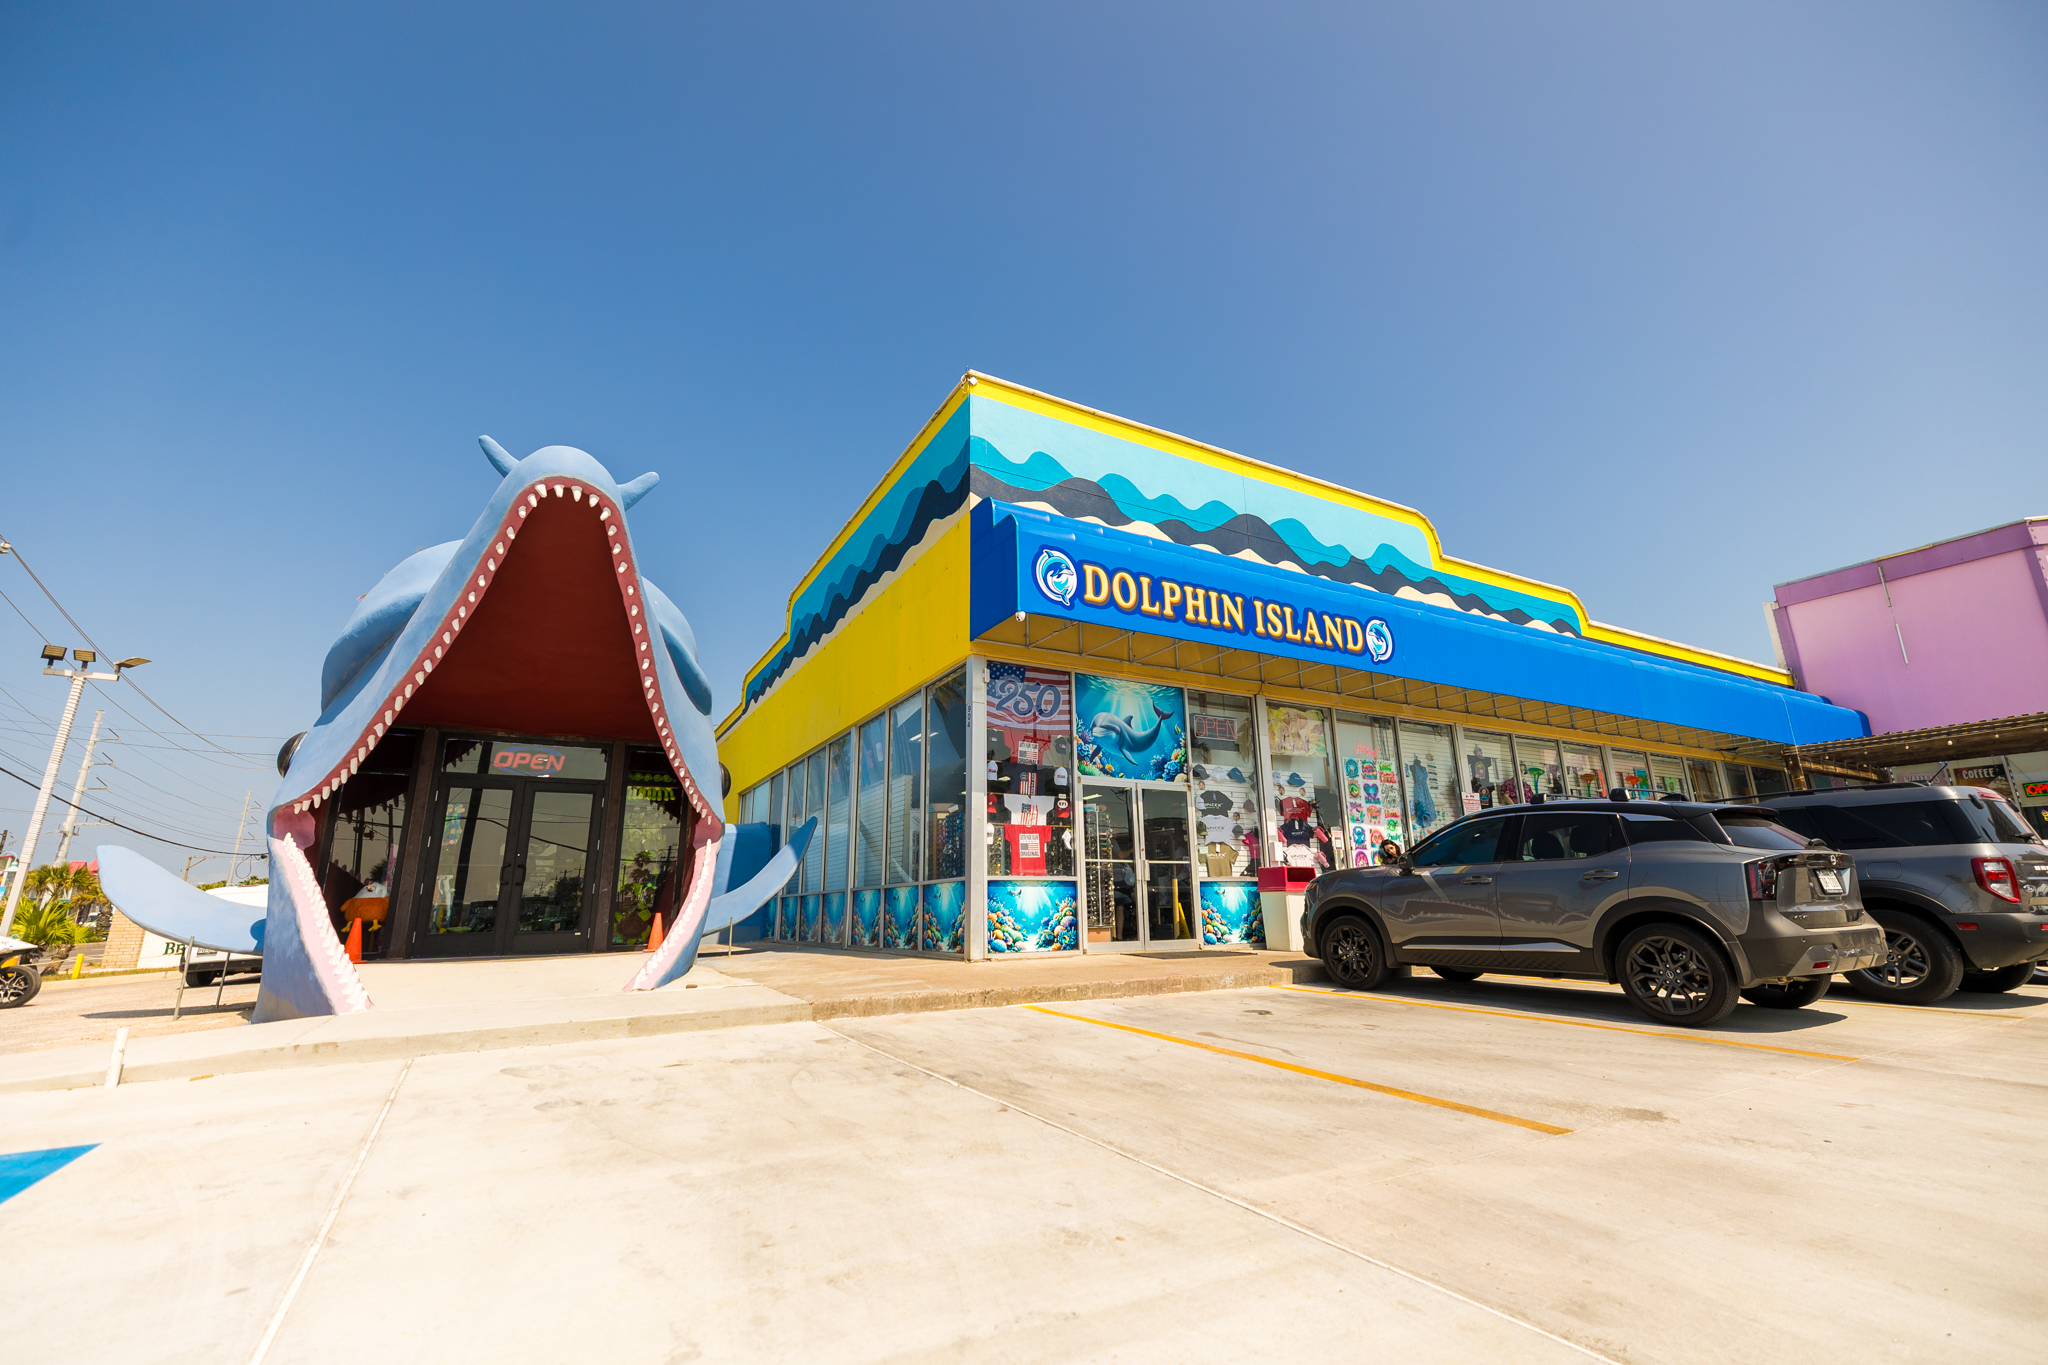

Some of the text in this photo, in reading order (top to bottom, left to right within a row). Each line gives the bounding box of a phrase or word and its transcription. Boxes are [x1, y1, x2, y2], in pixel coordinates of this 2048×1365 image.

[1083, 563, 1365, 652] DOLPHIN ISLAND
[996, 680, 1061, 718] 250
[1195, 716, 1237, 740] OPEN
[493, 751, 565, 771] OPEN
[1962, 768, 1995, 780] COFFEE
